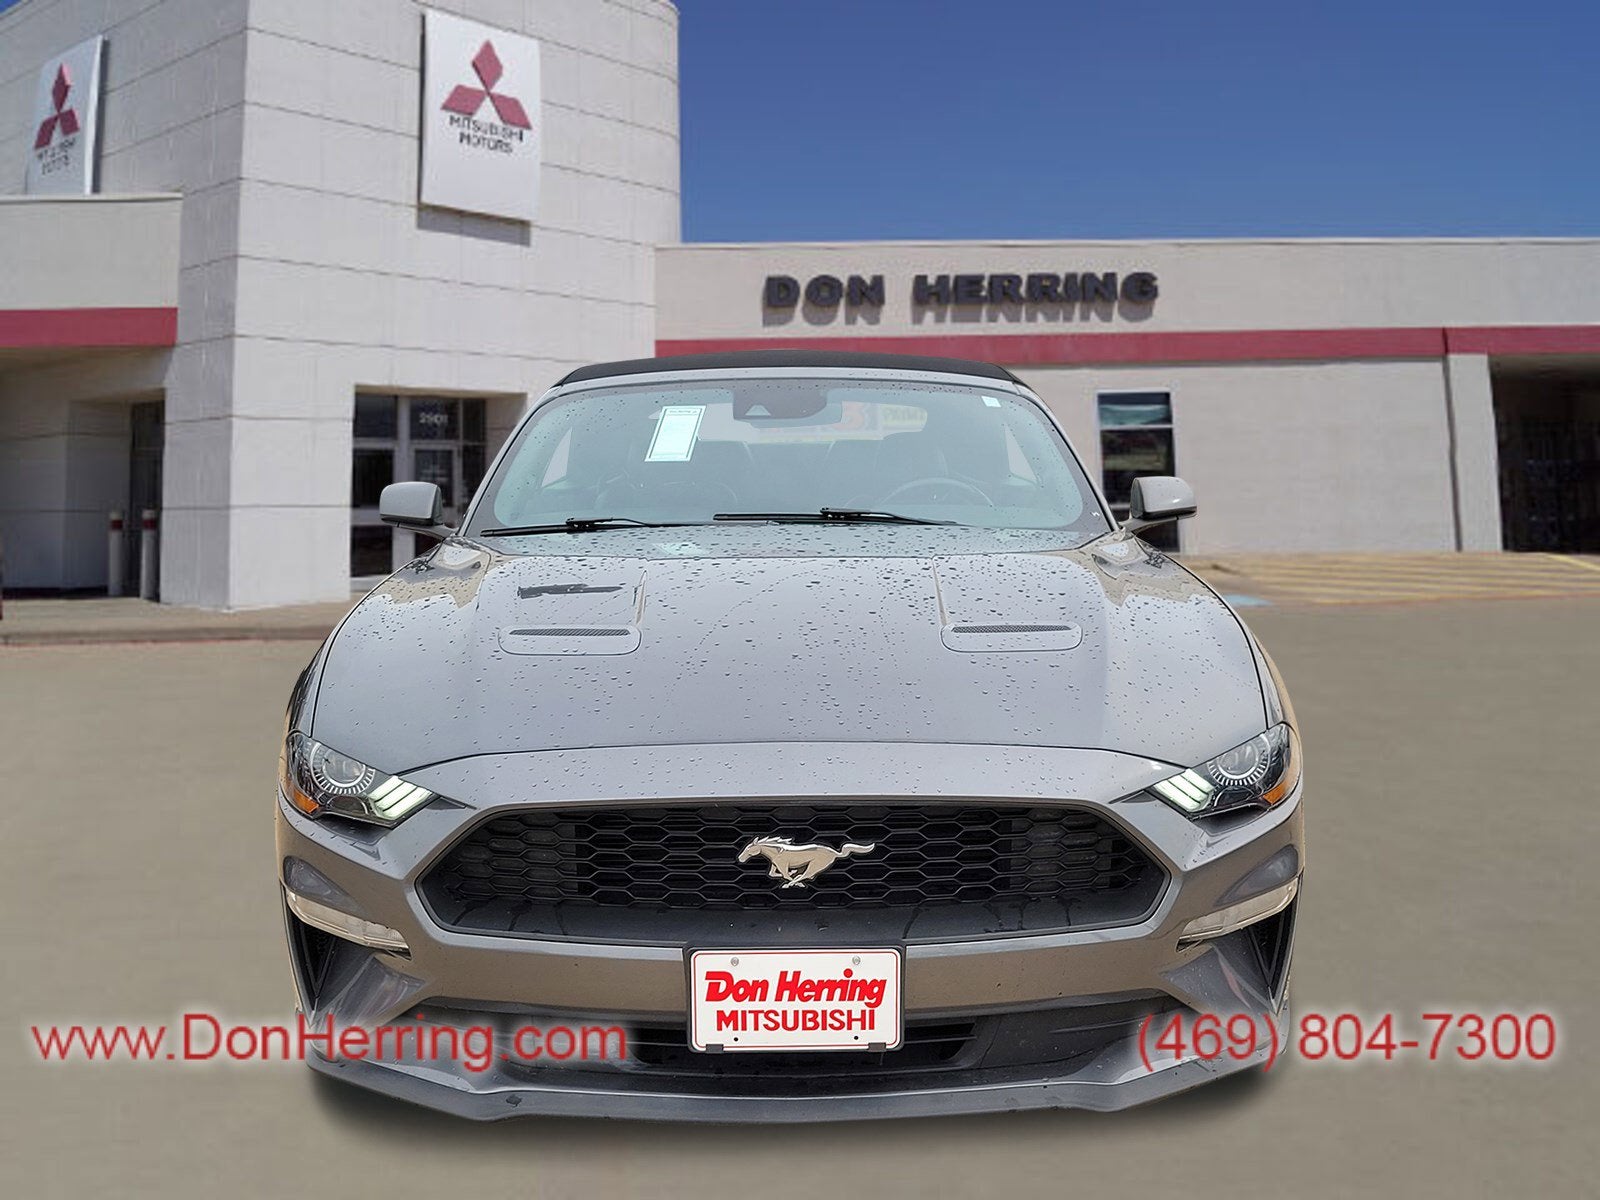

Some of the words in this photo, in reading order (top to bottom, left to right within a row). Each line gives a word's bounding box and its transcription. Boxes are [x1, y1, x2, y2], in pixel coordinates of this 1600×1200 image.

[448, 115, 524, 142] MITSUBISHI
[459, 132, 513, 153] MOTORS
[765, 274, 885, 306] DON
[912, 271, 1159, 304] HERRING
[704, 970, 770, 1003] Don
[773, 967, 888, 1009] Herring
[716, 1009, 876, 1032] MITSUBISHI
